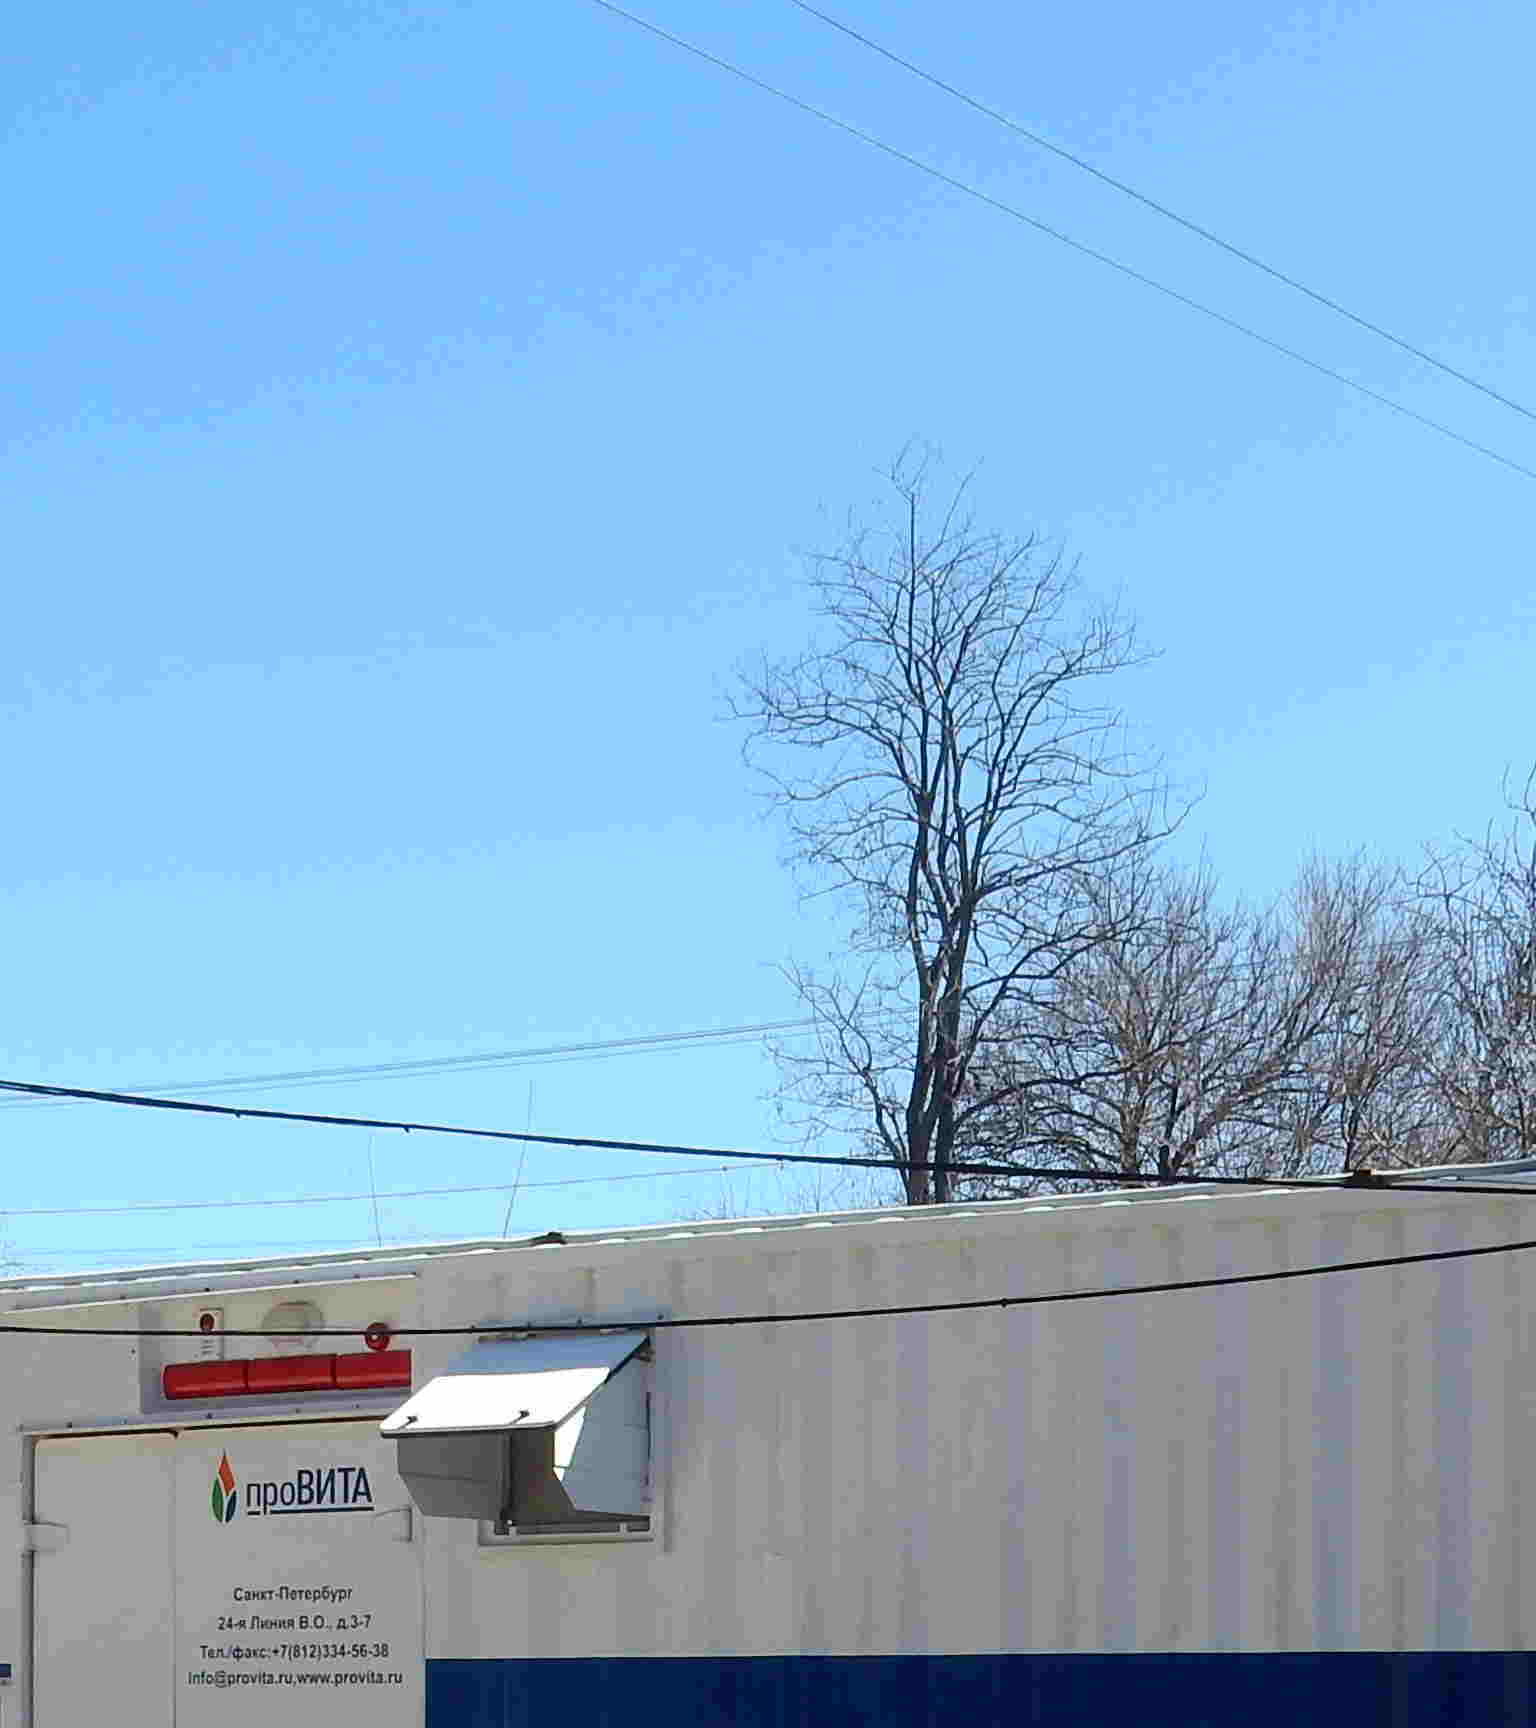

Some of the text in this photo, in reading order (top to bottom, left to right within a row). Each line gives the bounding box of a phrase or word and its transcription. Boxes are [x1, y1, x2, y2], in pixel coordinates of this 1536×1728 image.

[246, 1468, 373, 1515] проВИТА
[233, 1585, 353, 1603] Санкт-Петербург
[217, 1617, 247, 1630] 24-я
[250, 1616, 295, 1630] Линия
[336, 1614, 372, 1630] д.3-7
